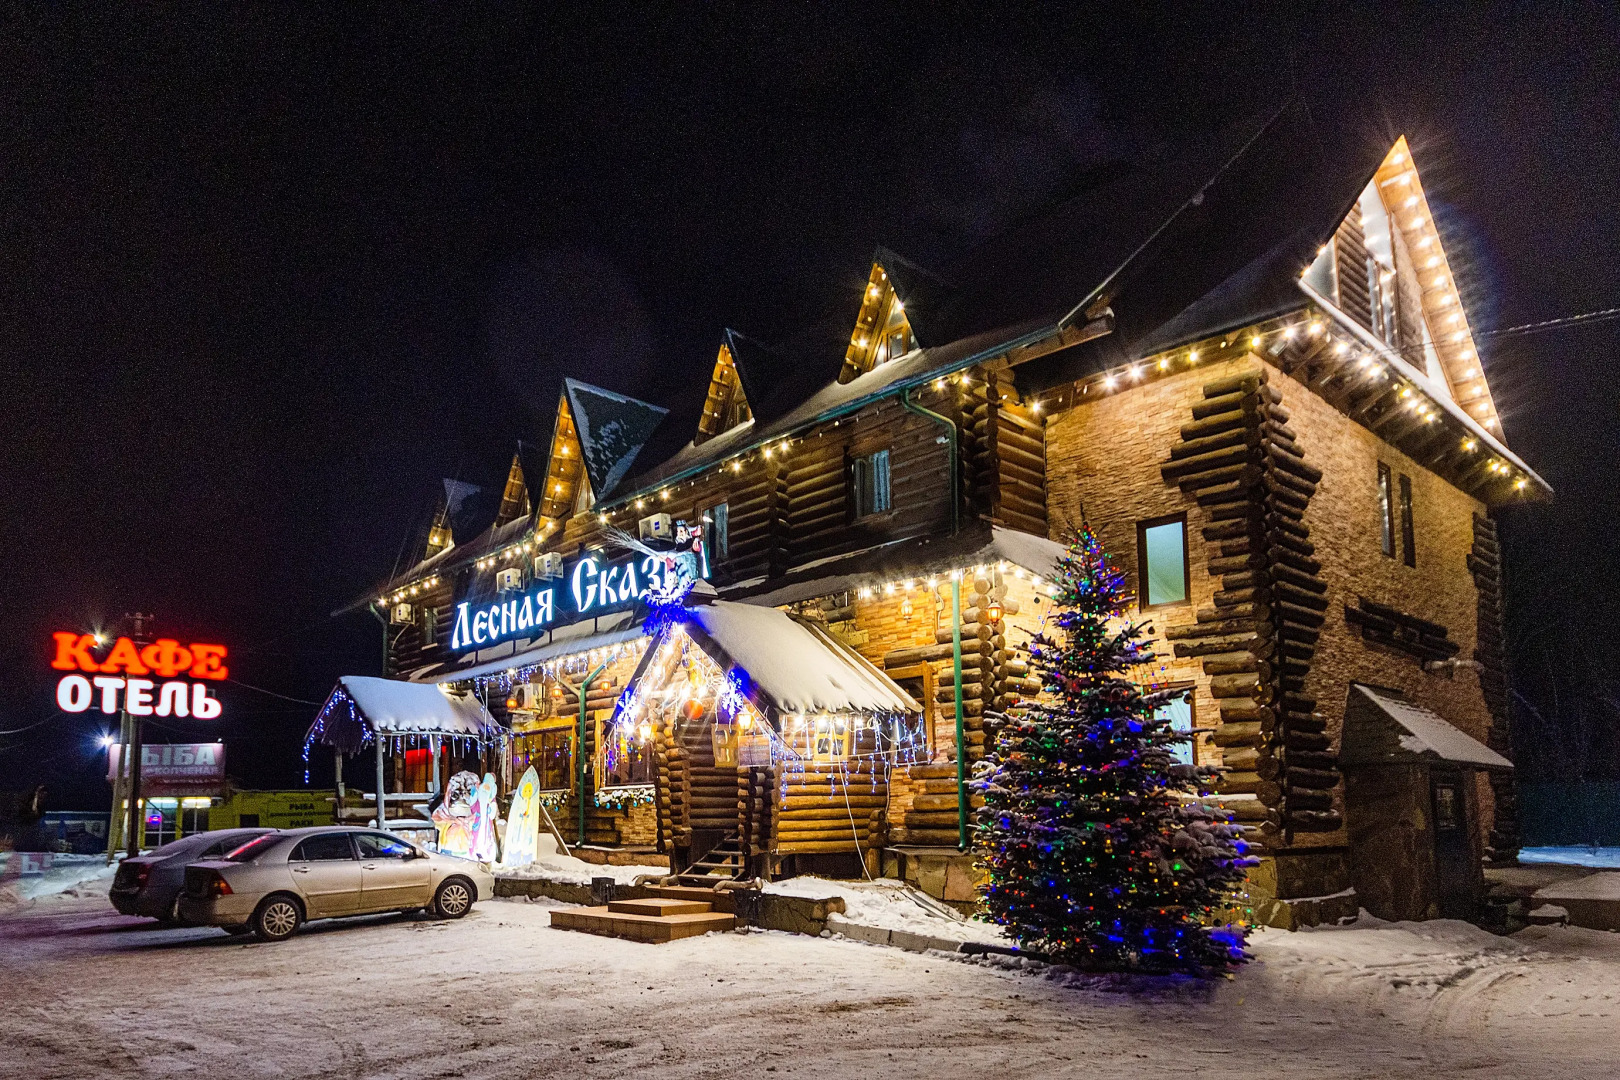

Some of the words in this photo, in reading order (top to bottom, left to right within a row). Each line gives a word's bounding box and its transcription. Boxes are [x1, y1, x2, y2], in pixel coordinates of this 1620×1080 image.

[572, 543, 708, 612] Сказ
[52, 631, 228, 680] КАФЕ
[57, 674, 222, 719] ОТЕЛЬ
[125, 746, 216, 766] ЫБА
